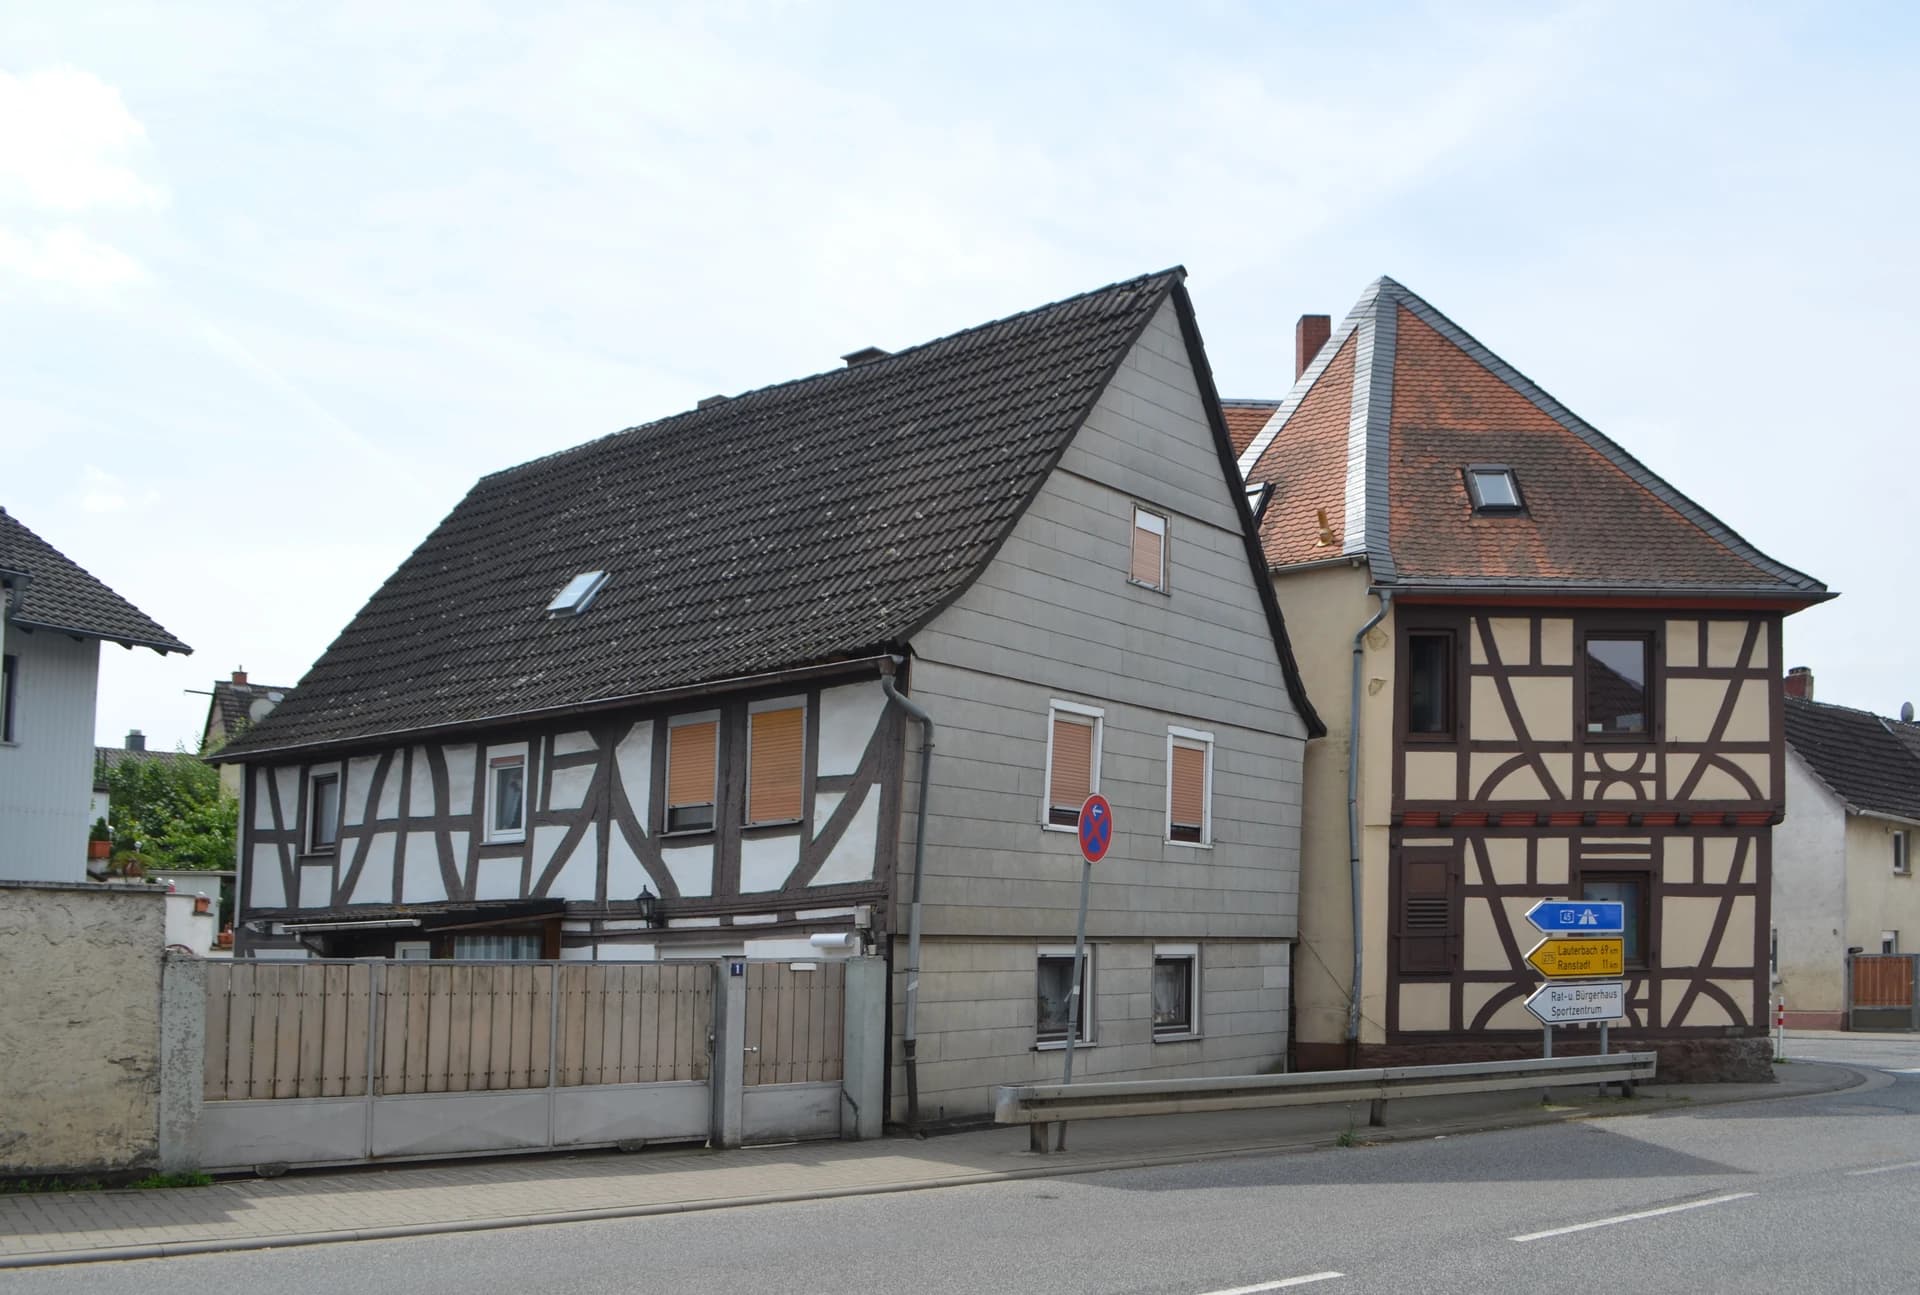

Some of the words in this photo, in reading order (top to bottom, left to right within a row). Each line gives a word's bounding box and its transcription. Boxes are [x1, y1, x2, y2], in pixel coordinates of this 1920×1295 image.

[1558, 945, 1598, 956] Lauterbach
[1600, 945, 1609, 955] 69
[1558, 960, 1591, 970] Ranstadt
[1602, 960, 1609, 969] 11
[1575, 989, 1618, 1002] Bürgerhaus
[1551, 1005, 1602, 1018] Sportzentrum
